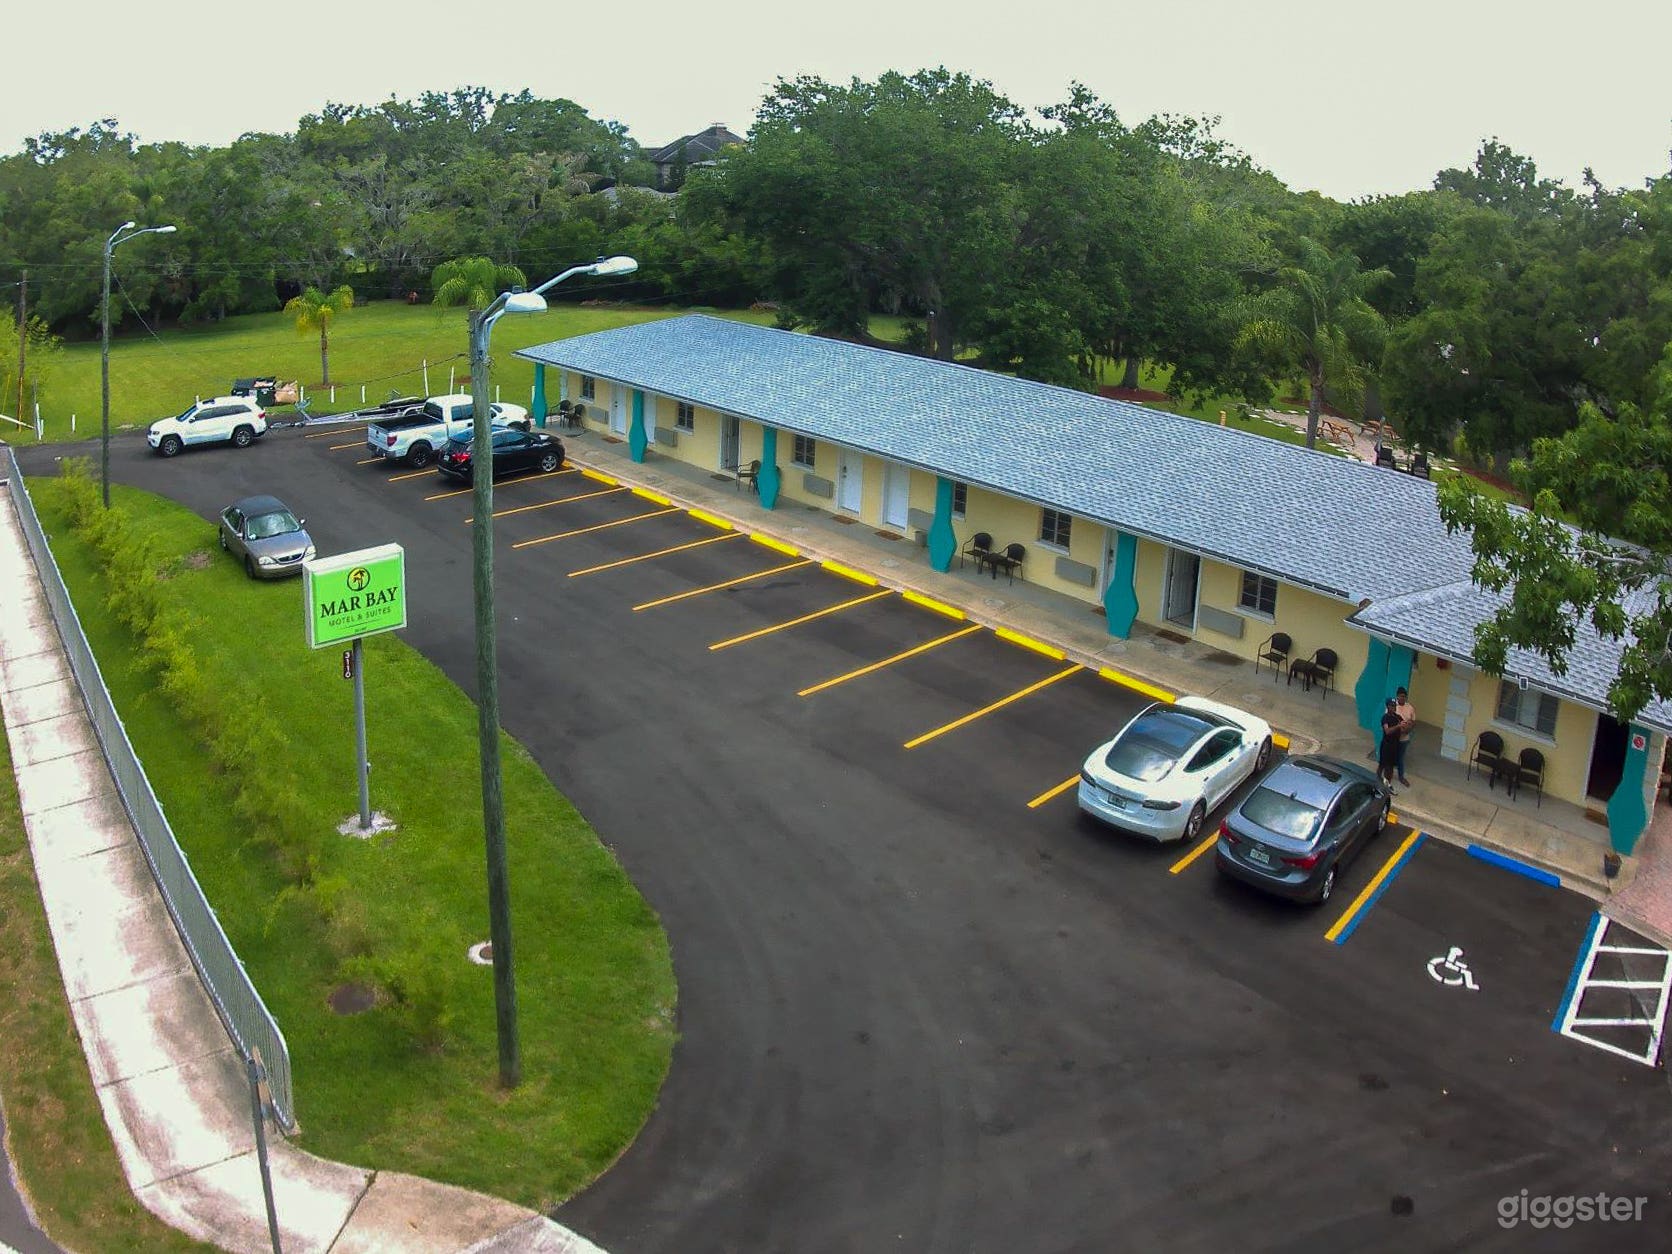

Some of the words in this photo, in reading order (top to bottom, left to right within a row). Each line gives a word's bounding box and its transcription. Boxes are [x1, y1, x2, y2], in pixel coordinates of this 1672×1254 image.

[320, 596, 361, 618] MAR
[365, 586, 398, 607] BAY
[328, 614, 354, 627] MOTEL
[366, 606, 391, 618] SUITES
